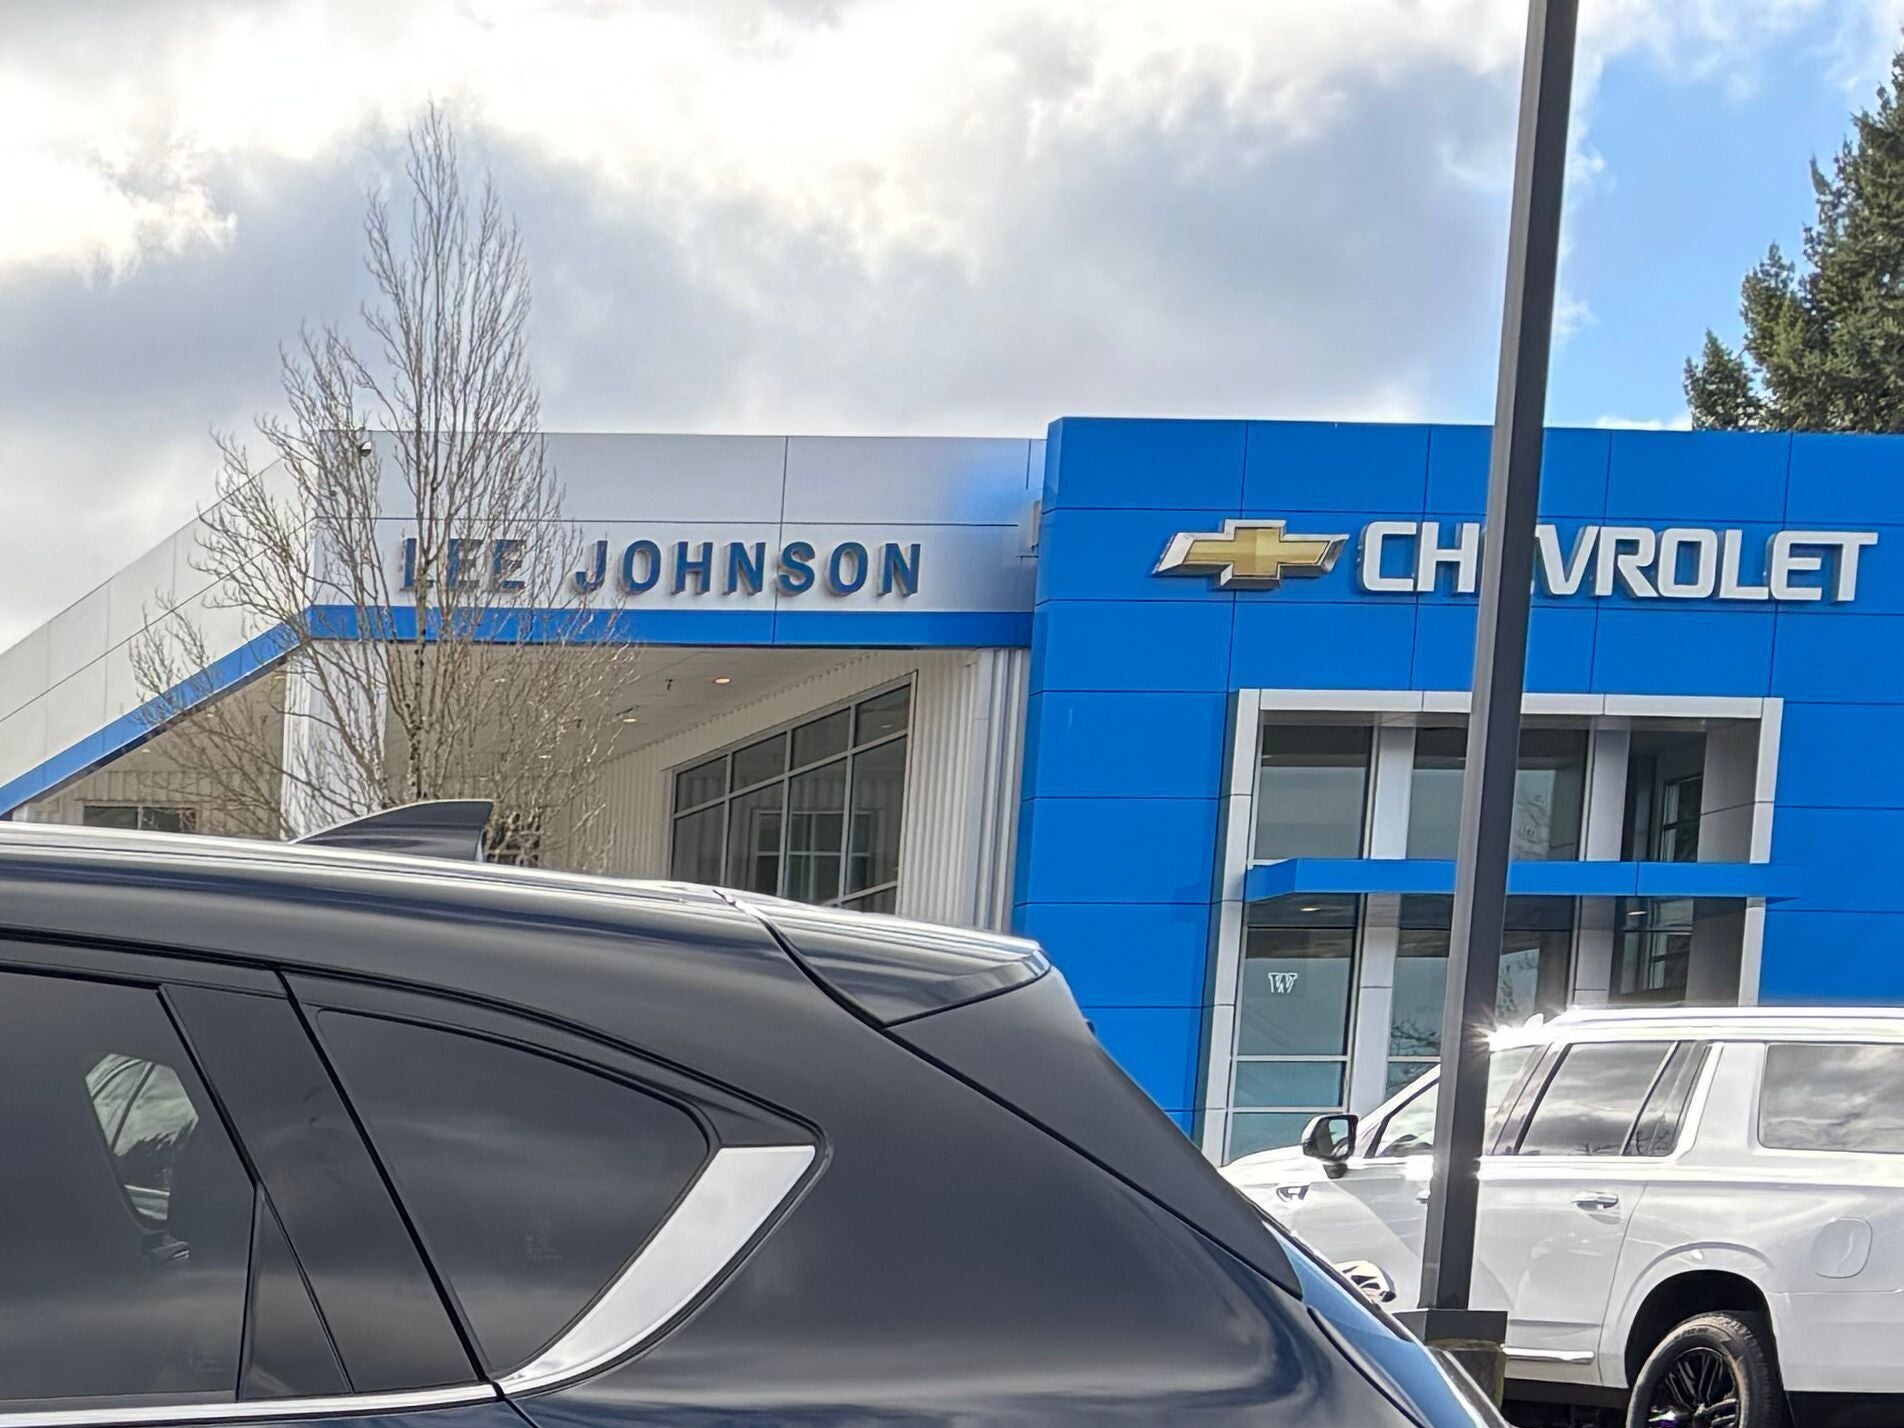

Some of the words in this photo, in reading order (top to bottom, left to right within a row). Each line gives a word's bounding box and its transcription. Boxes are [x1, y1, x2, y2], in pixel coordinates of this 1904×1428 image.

[400, 537, 526, 593] LEE
[574, 539, 921, 597] JOHNSON
[1362, 520, 1879, 602] CHVROLET
